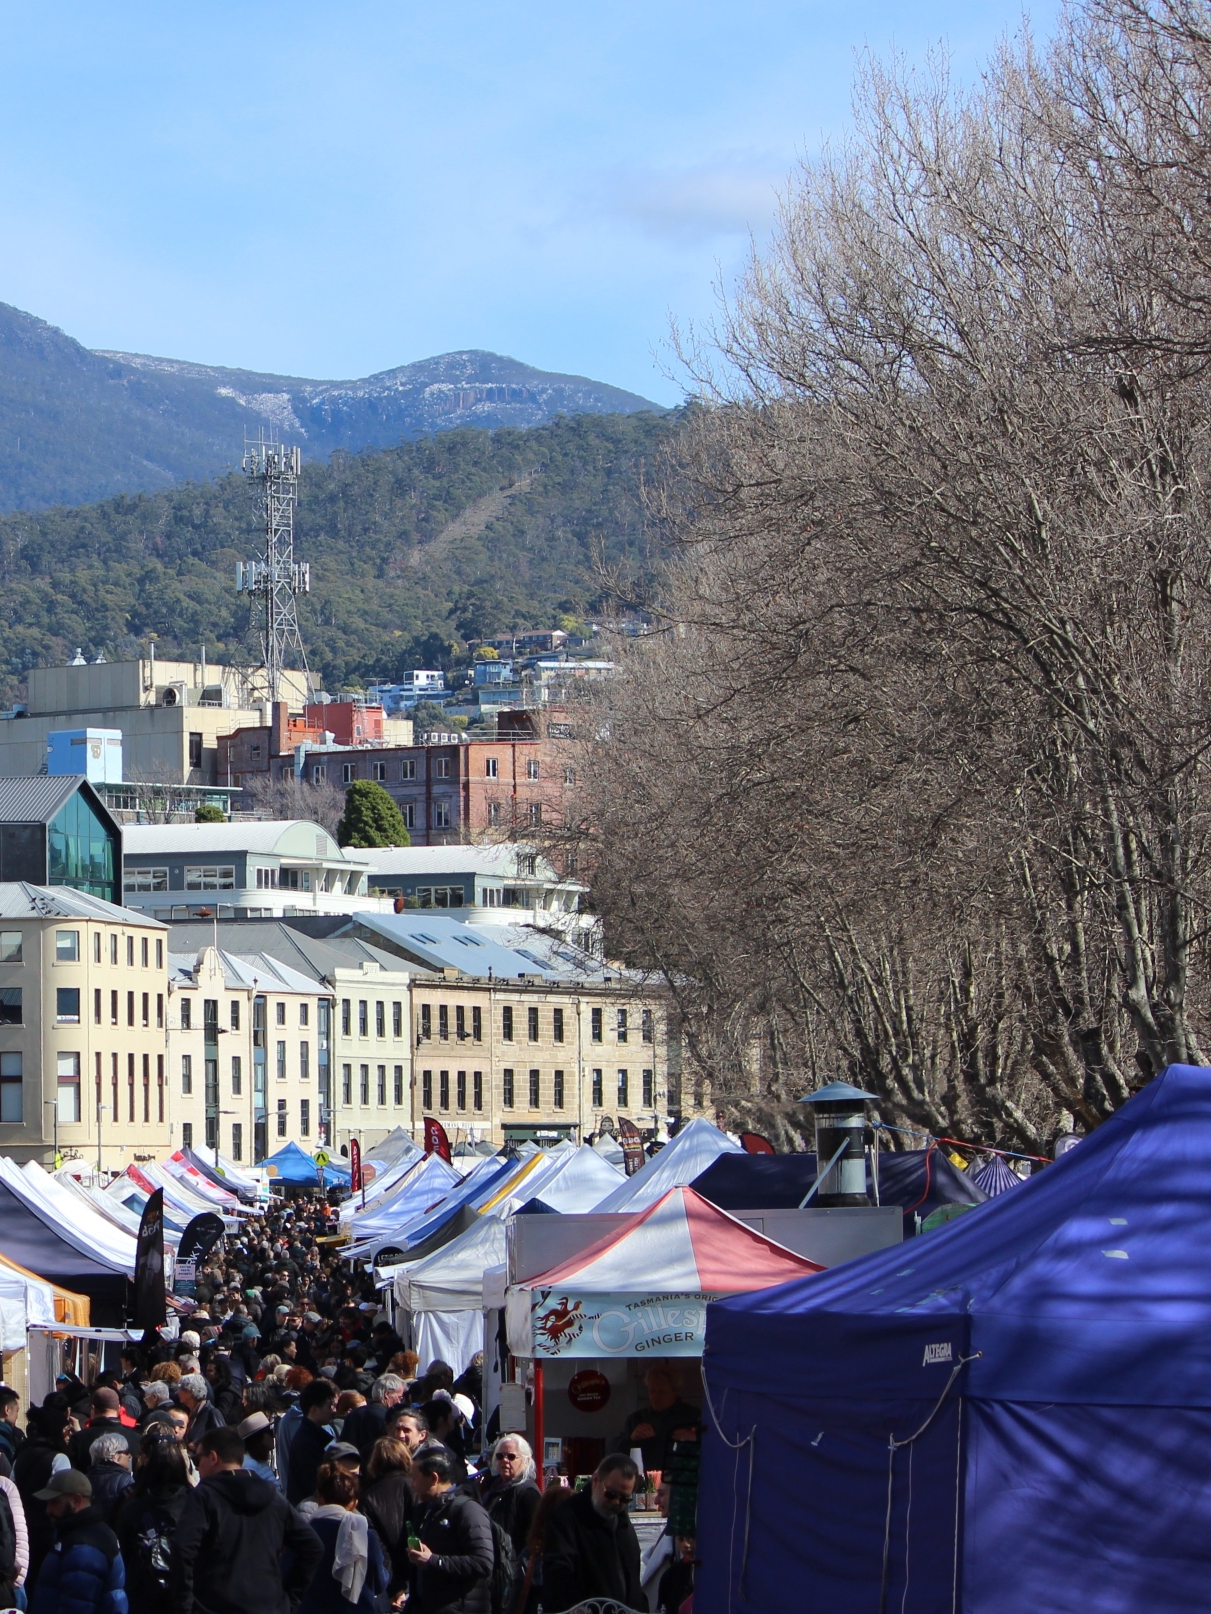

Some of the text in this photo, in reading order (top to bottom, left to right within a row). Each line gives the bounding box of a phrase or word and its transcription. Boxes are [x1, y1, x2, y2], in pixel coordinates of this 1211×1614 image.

[625, 1293, 690, 1312] TASMANIA'S
[634, 1331, 694, 1352] GINGER
[922, 1342, 952, 1367] ALTEGRA
